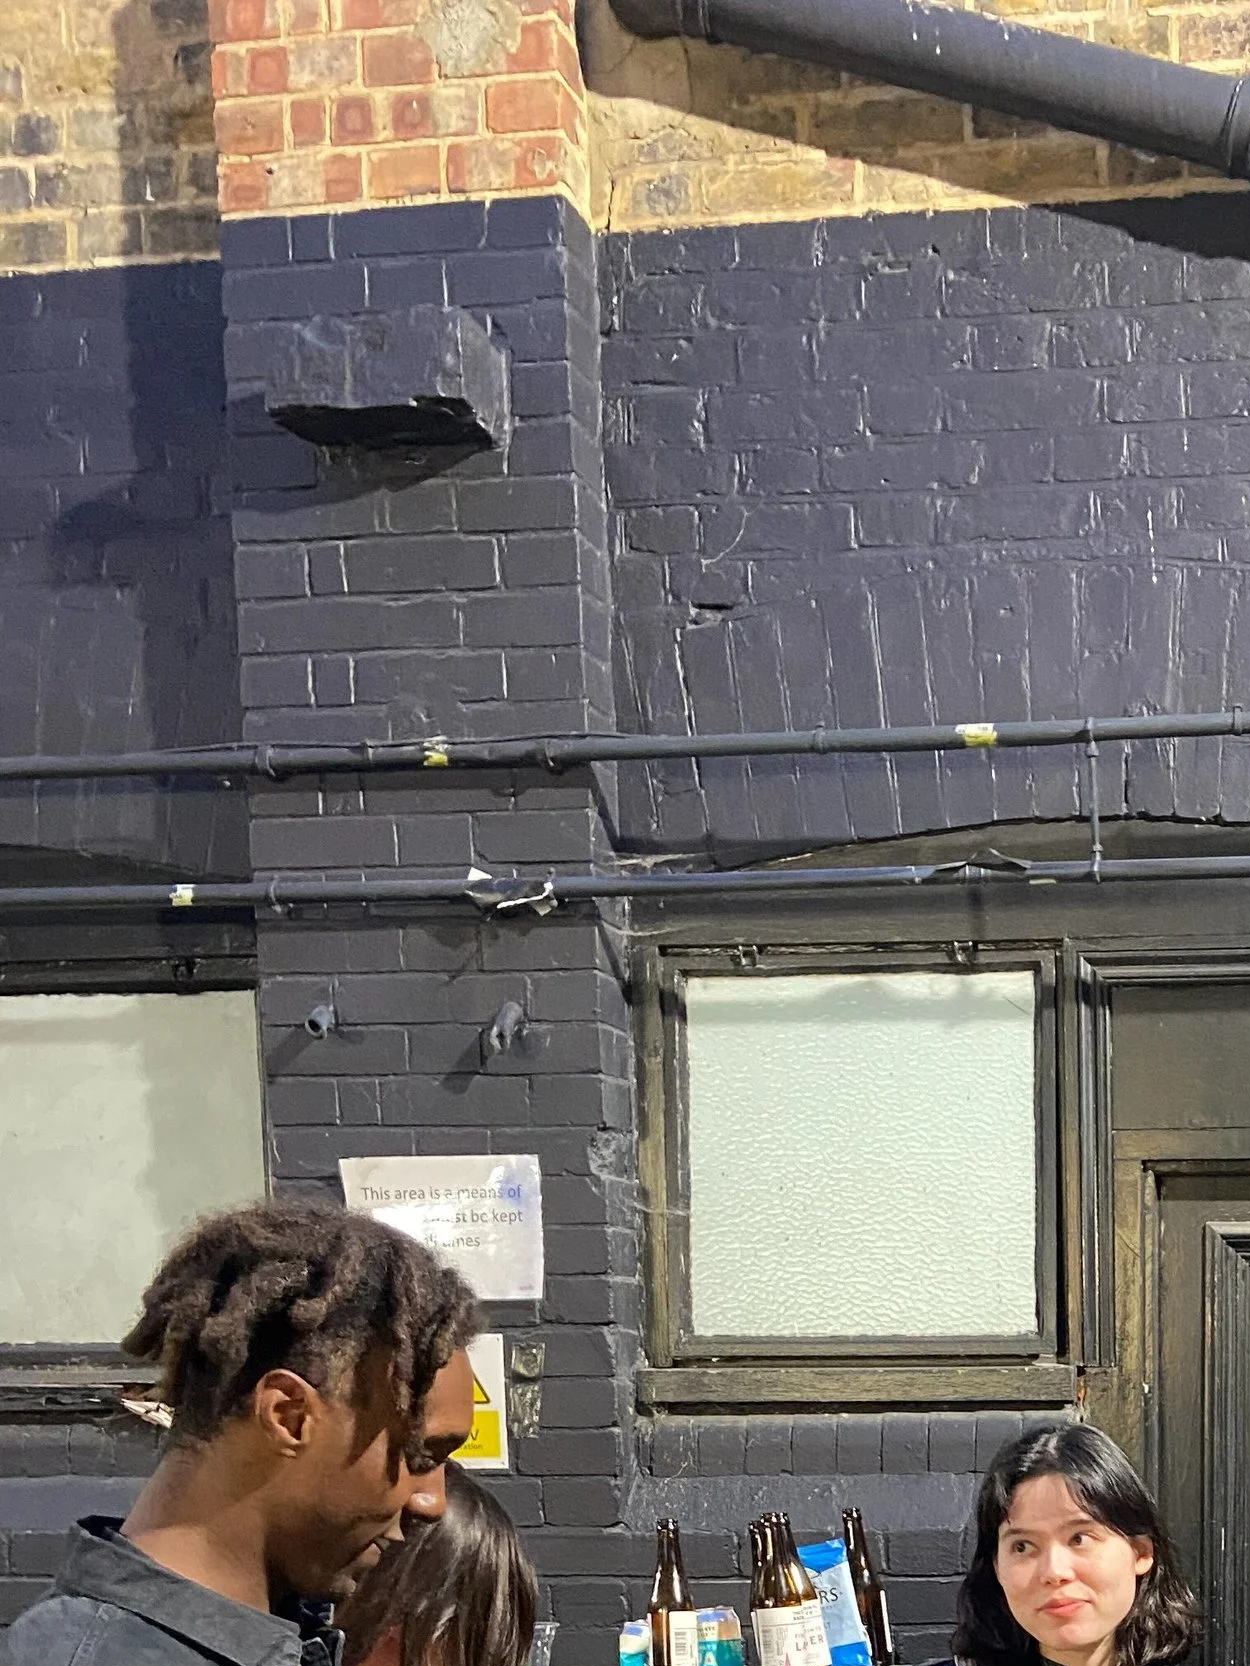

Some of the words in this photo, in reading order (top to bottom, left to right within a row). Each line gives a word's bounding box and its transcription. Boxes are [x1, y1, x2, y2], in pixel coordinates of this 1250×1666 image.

[361, 1186, 390, 1200] This
[395, 1188, 425, 1199] area
[430, 1186, 440, 1199] is
[457, 1188, 503, 1199] means
[507, 1184, 522, 1198] of
[493, 1208, 523, 1225] kept
